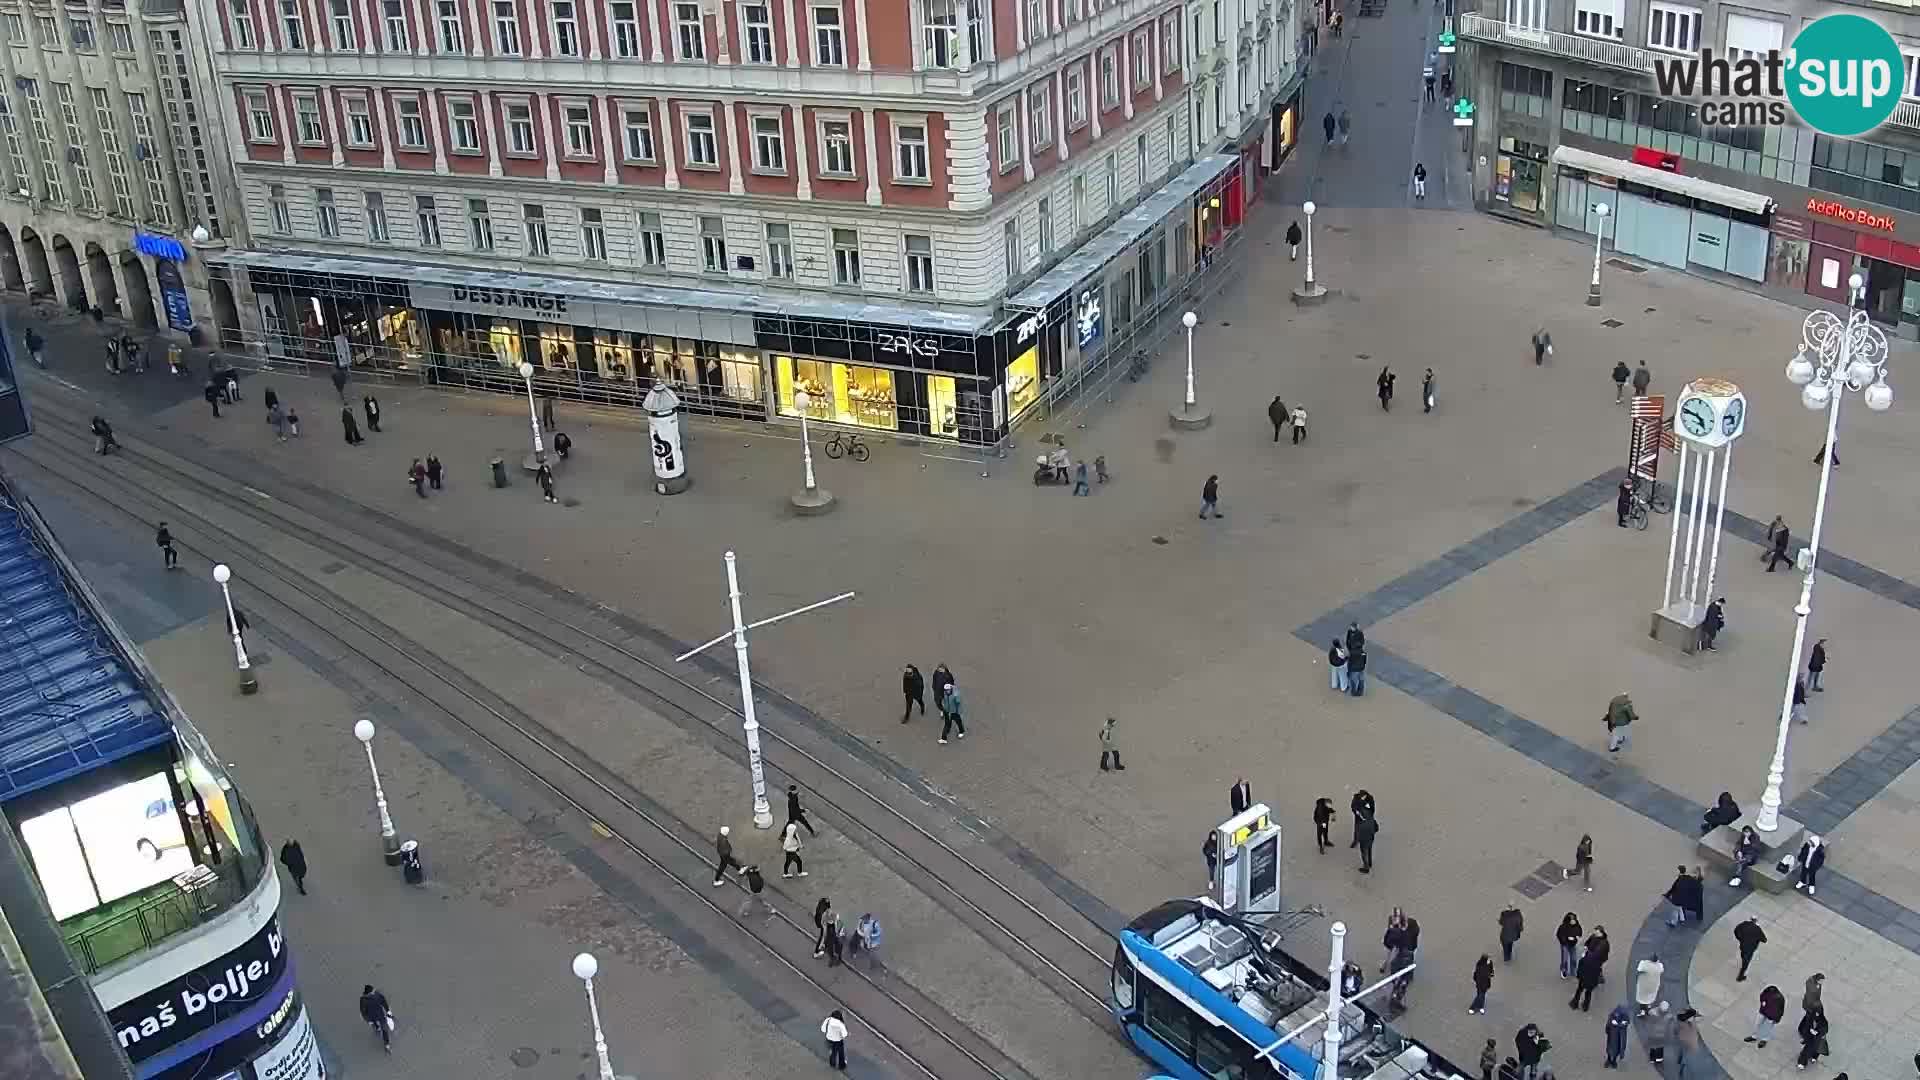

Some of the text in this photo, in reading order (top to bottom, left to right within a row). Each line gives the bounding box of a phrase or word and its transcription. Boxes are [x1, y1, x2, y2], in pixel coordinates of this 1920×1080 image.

[1807, 199, 1896, 232] Addiko Bank
[453, 284, 567, 313] DESSANGE
[1016, 307, 1047, 345] ZAKS
[877, 334, 938, 356] ZAKS
[117, 1000, 177, 1048] naš
[182, 960, 270, 1016] bolje,
